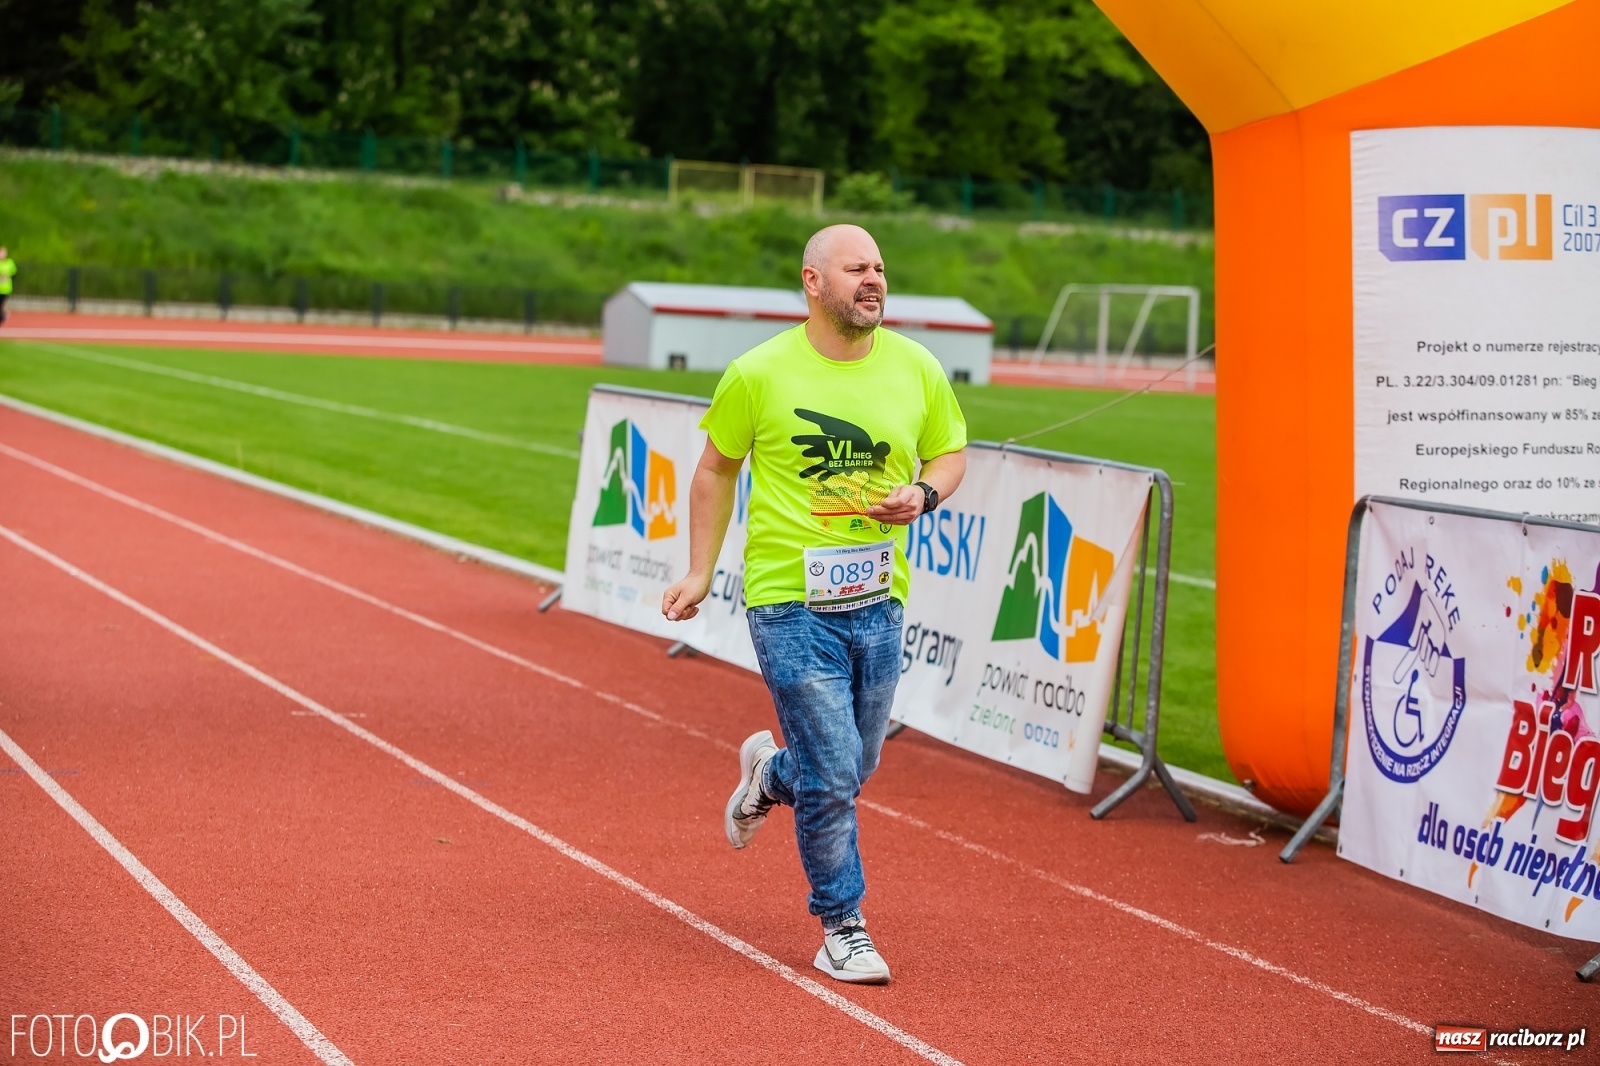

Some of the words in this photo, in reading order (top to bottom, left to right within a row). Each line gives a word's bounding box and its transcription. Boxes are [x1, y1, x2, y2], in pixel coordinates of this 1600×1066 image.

[1417, 340, 1468, 355] Projekt
[1472, 343, 1481, 353] o
[1486, 342, 1544, 353] numerze
[1376, 375, 1398, 388] PL.
[1403, 374, 1538, 388] 3.22/3.304/09.01281
[1387, 410, 1413, 425] jest
[1418, 409, 1547, 424] współfinansowany
[1552, 411, 1561, 421] w
[1565, 408, 1589, 421] 85%
[827, 440, 852, 460] VI
[852, 452, 872, 460] BIEG
[1416, 444, 1518, 459] Europejskiego
[1523, 443, 1584, 456] Funduszu
[828, 460, 843, 468] BEZ
[845, 460, 874, 468] BARIER
[1400, 478, 1499, 494] Regionalnego
[1503, 480, 1532, 490] oraz
[1536, 477, 1552, 490] do
[1557, 476, 1580, 490] 10%
[1584, 479, 1596, 489] ze
[880, 551, 890, 562] R
[829, 560, 875, 586] 089
[1372, 546, 1415, 615] PODAJ
[1424, 553, 1461, 632] RĘKĘ
[1496, 699, 1600, 844] Bieg
[1417, 801, 1448, 850] dla
